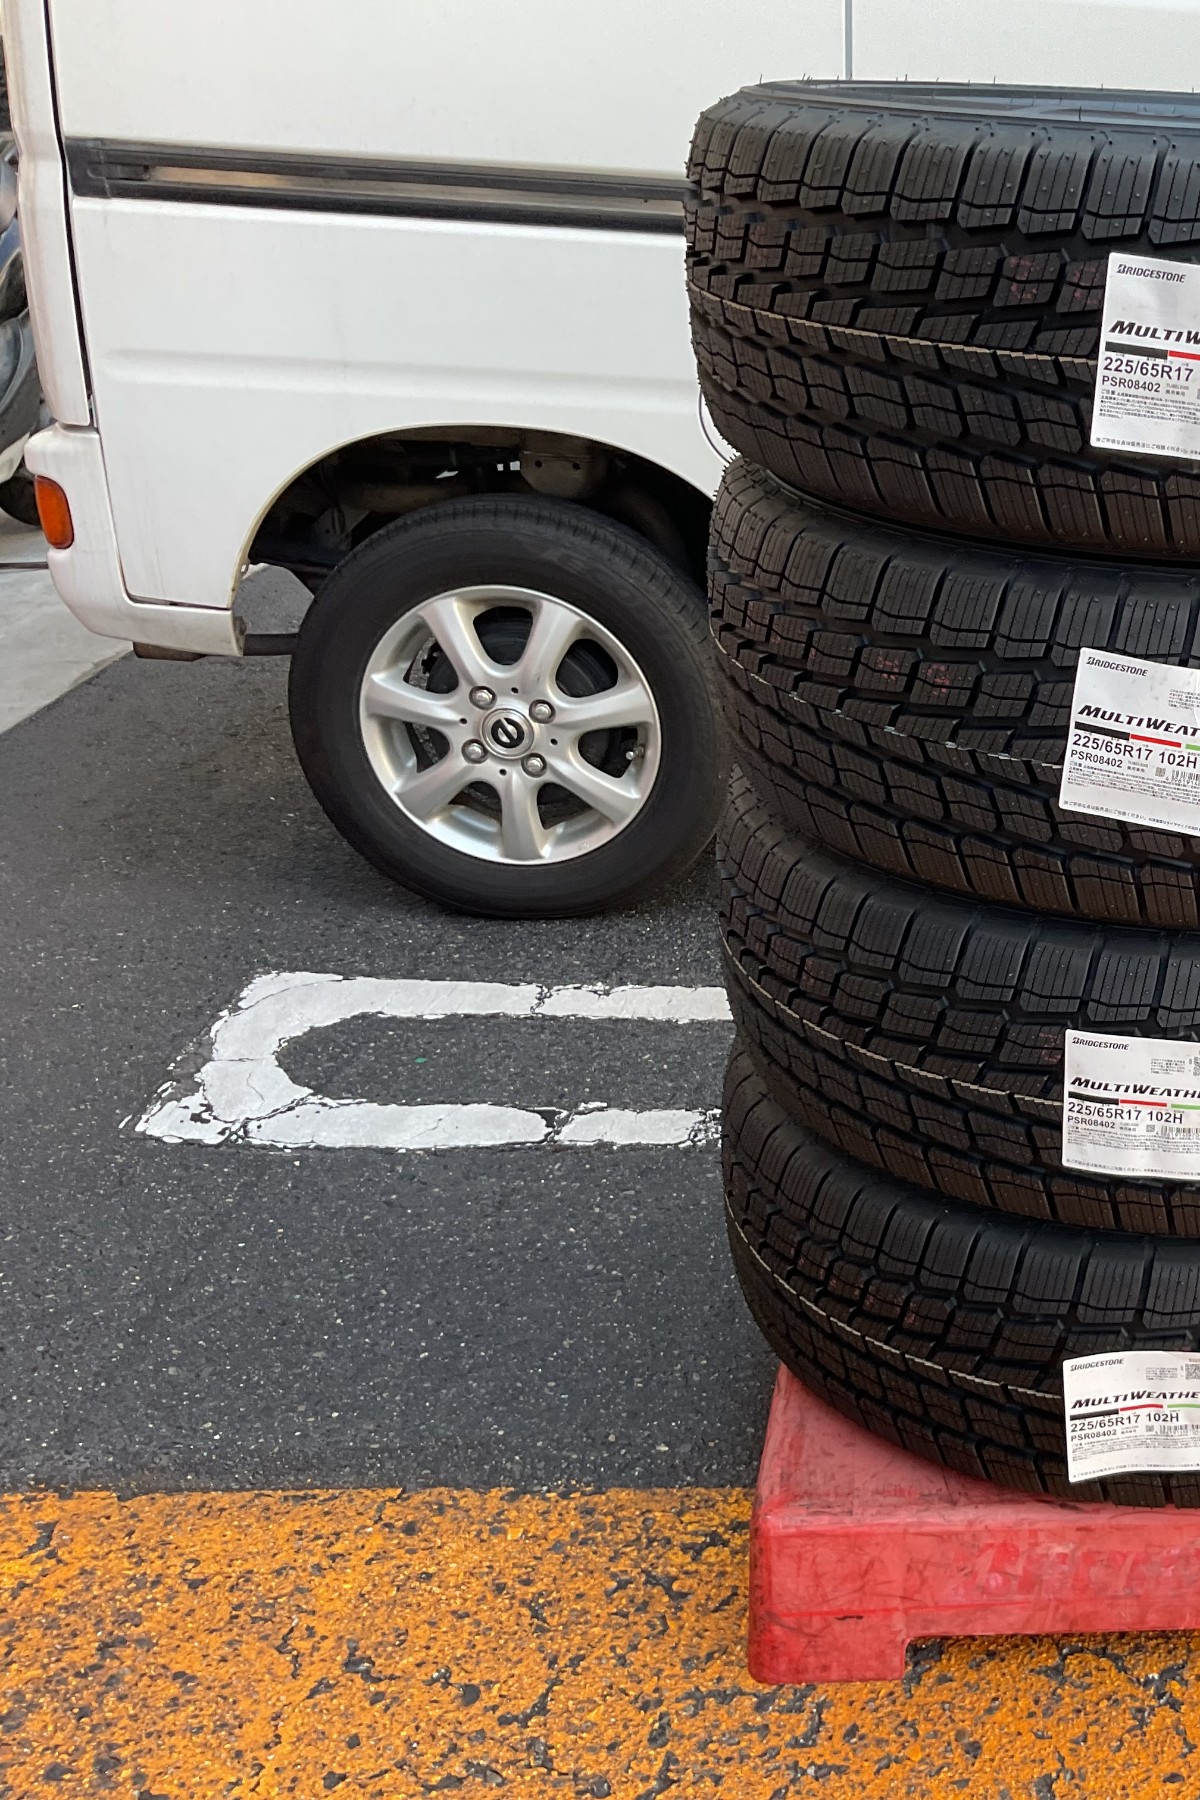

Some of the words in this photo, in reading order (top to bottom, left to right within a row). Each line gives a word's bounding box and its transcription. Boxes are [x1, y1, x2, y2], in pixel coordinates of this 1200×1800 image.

[1117, 264, 1186, 283] BRIDGESTONE
[1103, 357, 1194, 382] 225/65R17
[1102, 376, 1161, 393] PSR08402
[1086, 657, 1148, 677] BRIDGESTONE
[1070, 750, 1123, 768] PSR08402
[1073, 734, 1153, 760] 225/65R17
[1159, 751, 1197, 769] 102H
[1072, 1037, 1129, 1050] BRIDGESTONE
[1068, 1102, 1141, 1120] 225/65R17
[1148, 1112, 1183, 1124] 102H
[1068, 1116, 1115, 1129] PSR08402
[1070, 1358, 1124, 1371] BRIDGESTONE
[1070, 1415, 1140, 1433] 225/65R17
[1146, 1412, 1179, 1422] 102H
[1070, 1430, 1117, 1442] PSR08402
